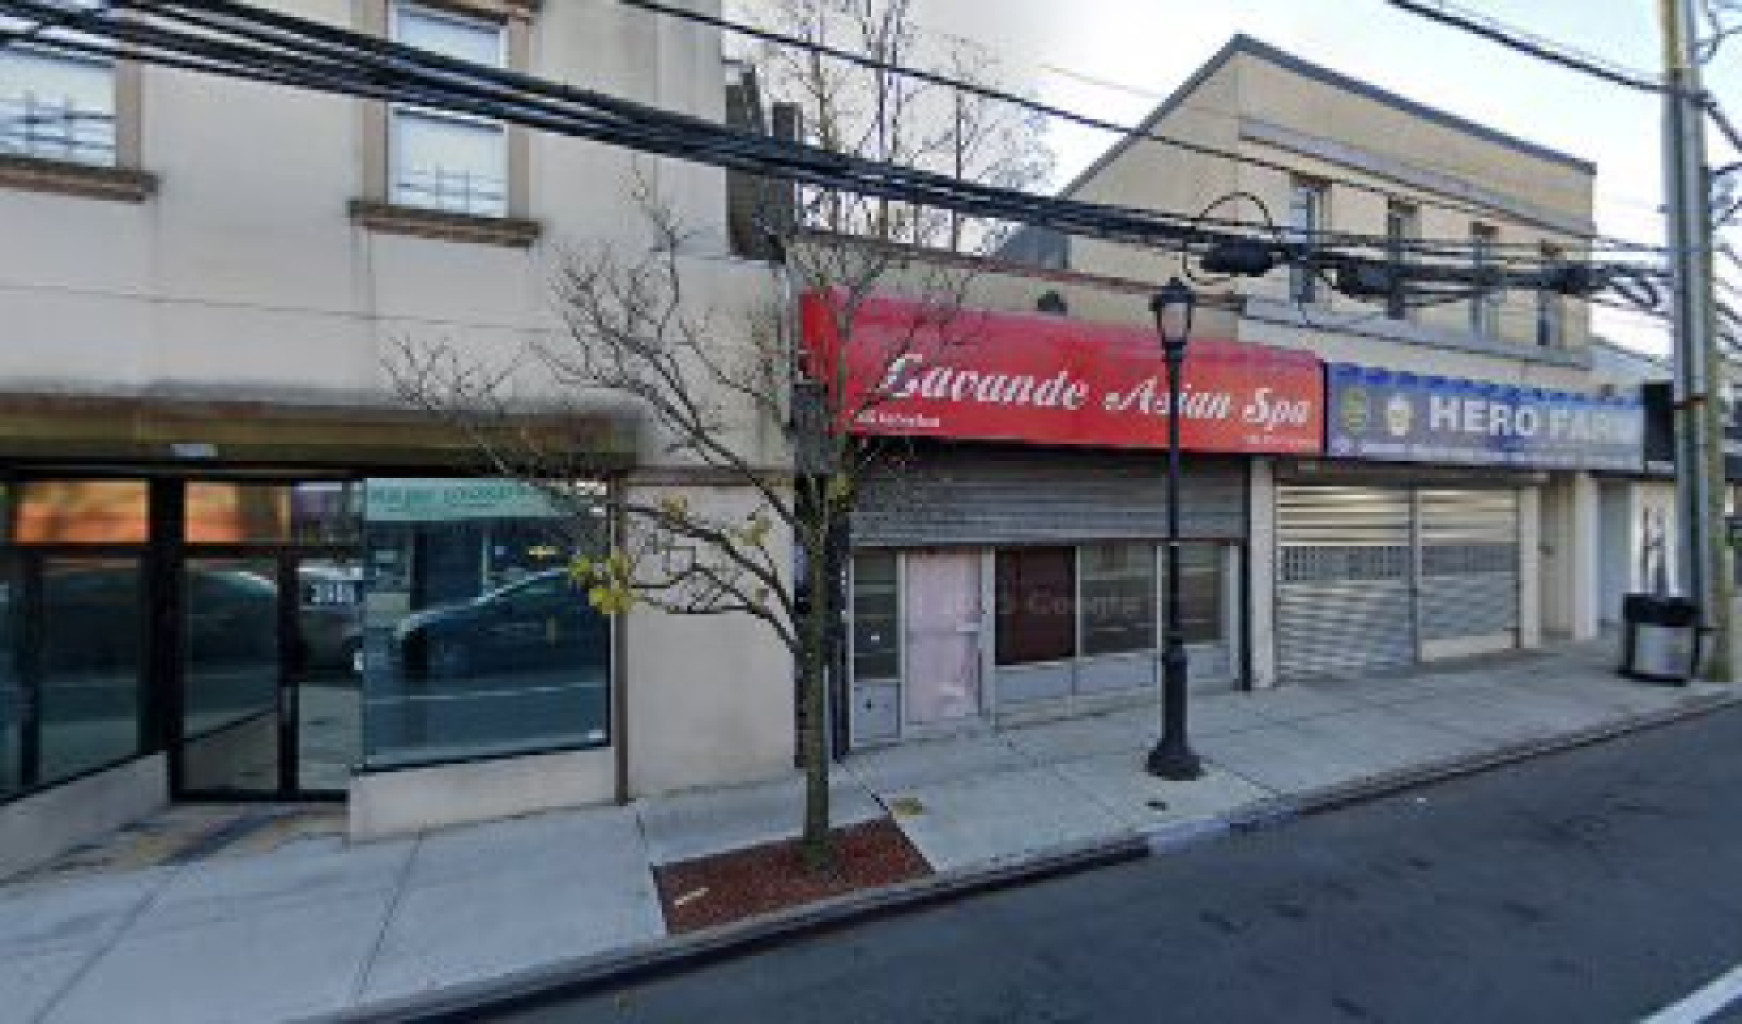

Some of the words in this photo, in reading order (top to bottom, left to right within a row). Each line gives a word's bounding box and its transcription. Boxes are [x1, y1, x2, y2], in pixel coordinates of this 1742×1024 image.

[882, 353, 1089, 410] Lavande
[1104, 376, 1231, 420] Asian
[1242, 387, 1311, 432] Spa
[1429, 395, 1539, 437] HERO
[1549, 409, 1638, 442] FAR
